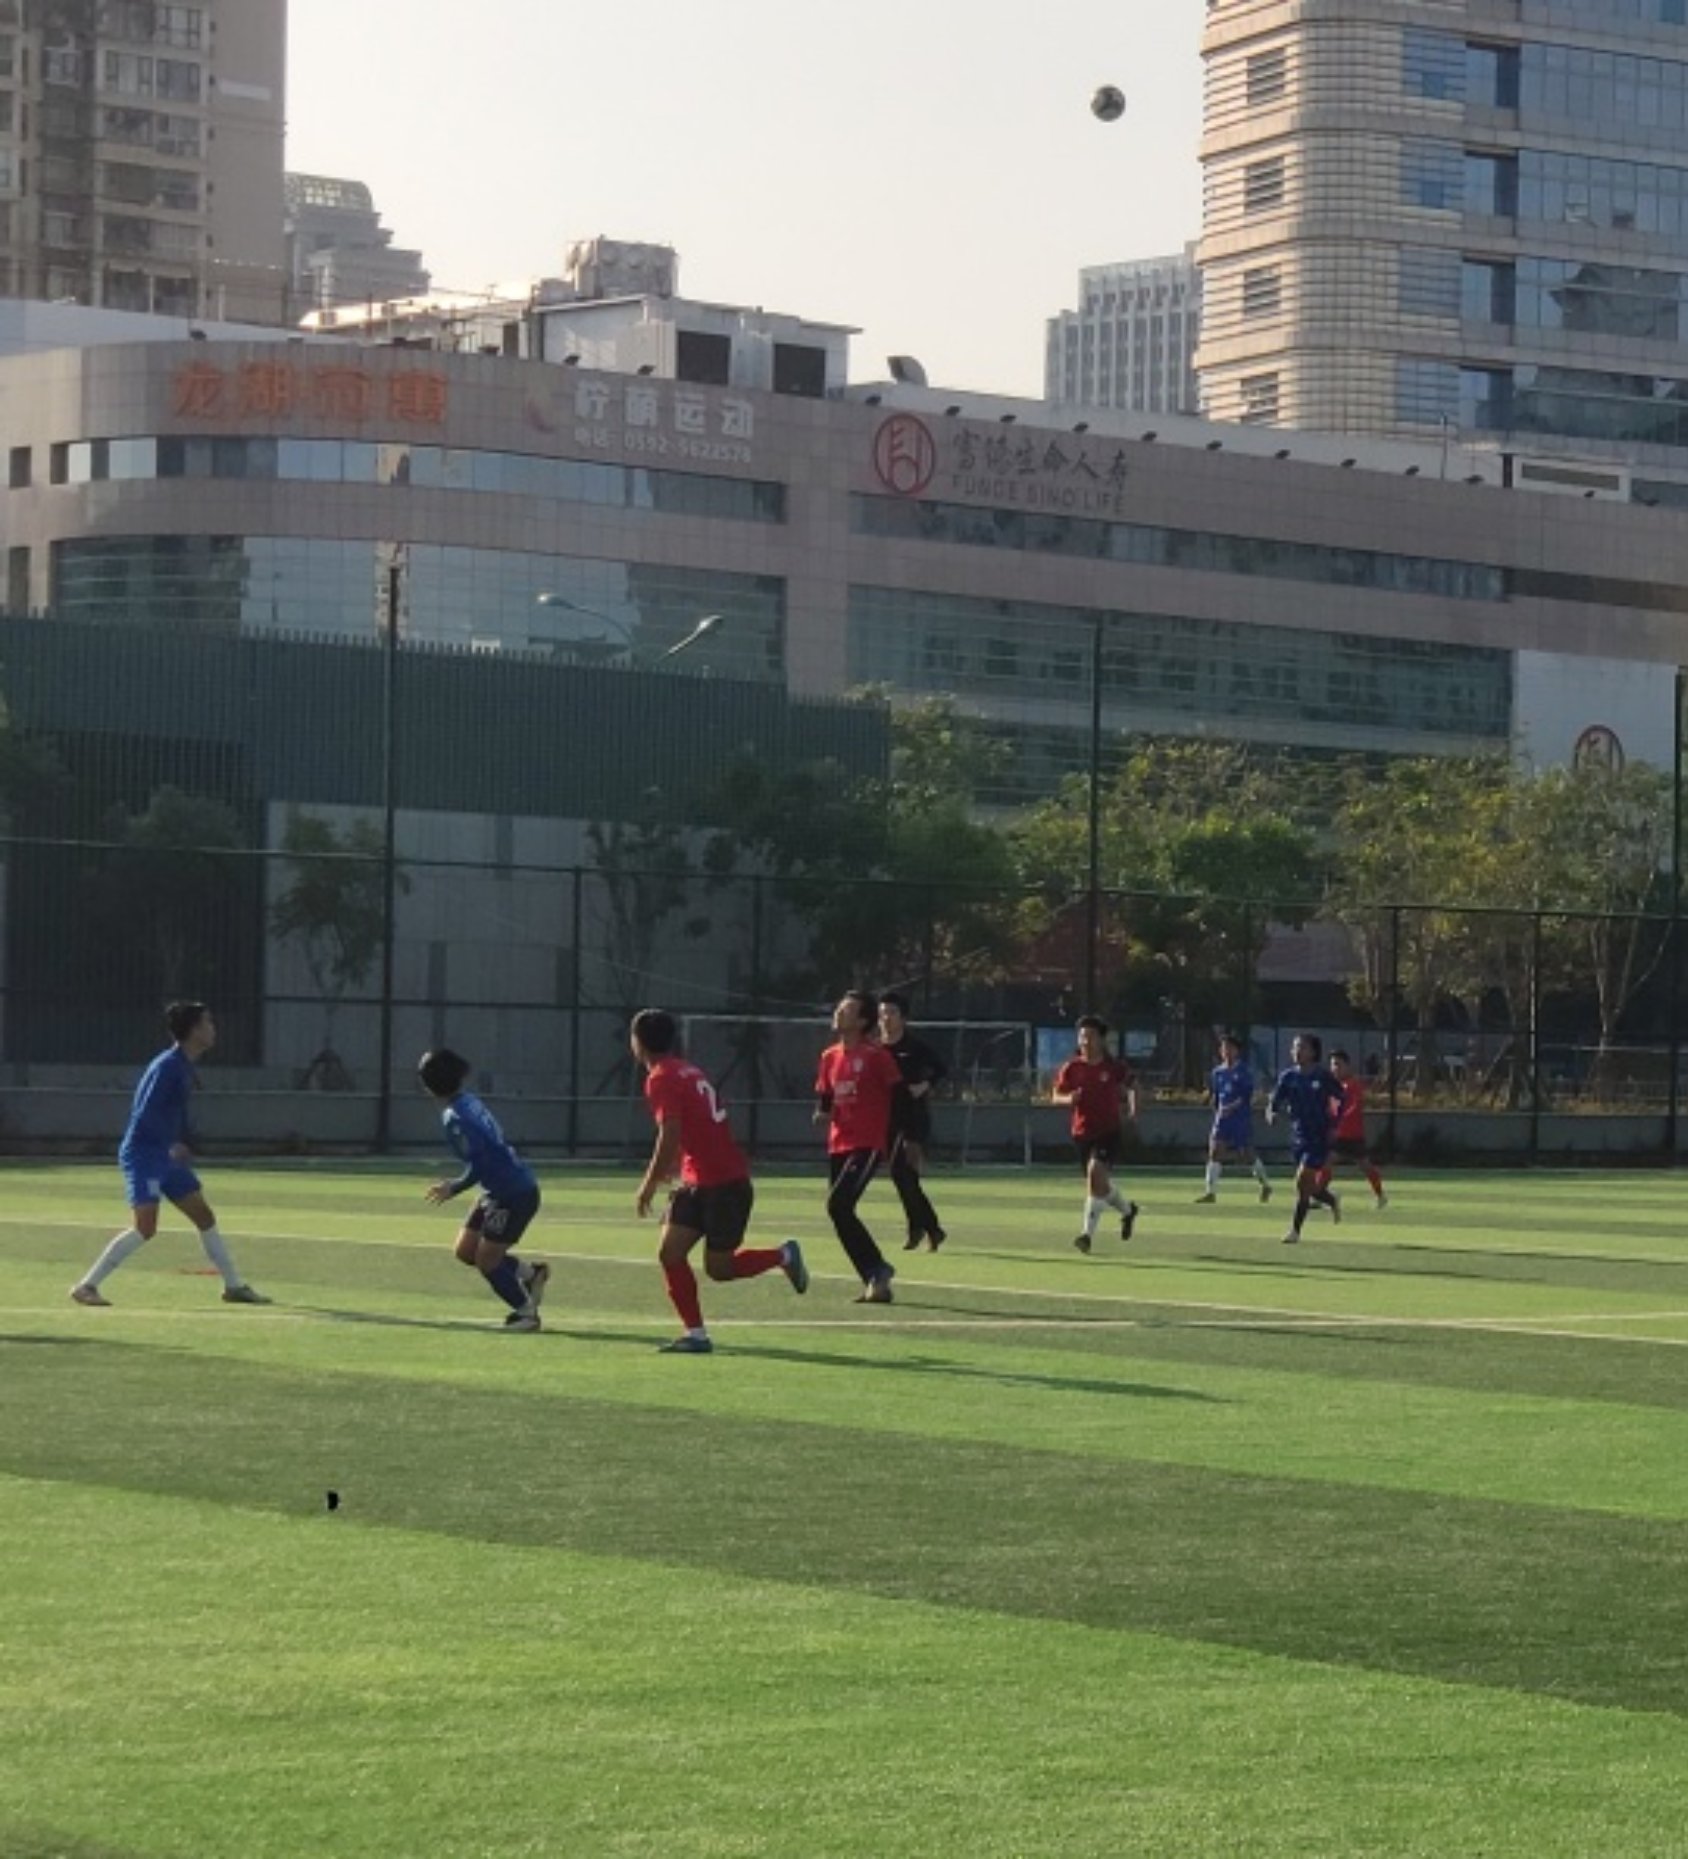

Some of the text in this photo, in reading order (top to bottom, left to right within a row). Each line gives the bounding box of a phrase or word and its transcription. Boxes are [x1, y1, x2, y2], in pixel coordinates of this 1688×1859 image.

[574, 379, 754, 439] 柠萌运动
[1083, 489, 1123, 513] LIFE
[696, 1079, 726, 1123] 2
